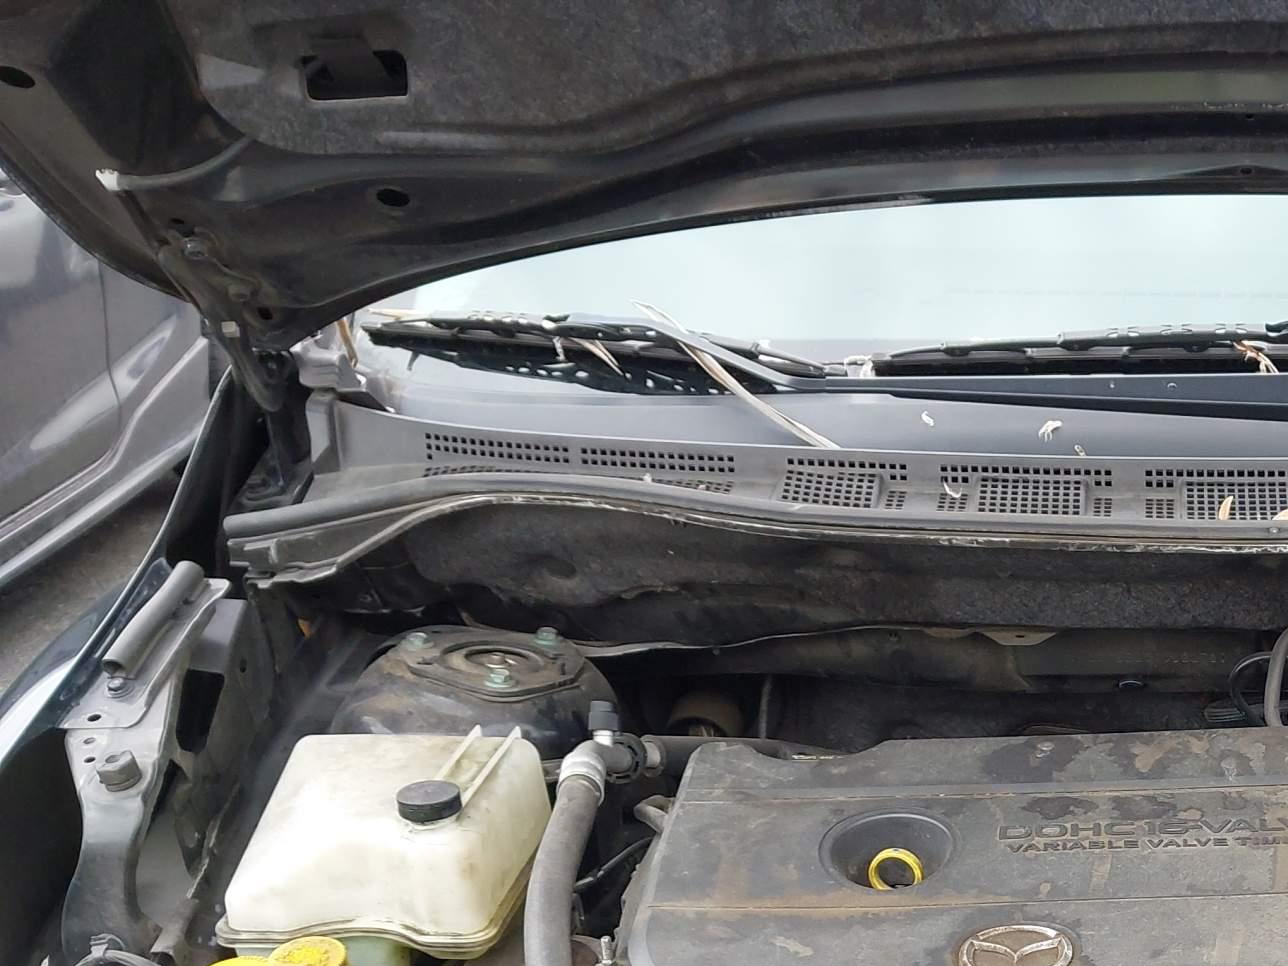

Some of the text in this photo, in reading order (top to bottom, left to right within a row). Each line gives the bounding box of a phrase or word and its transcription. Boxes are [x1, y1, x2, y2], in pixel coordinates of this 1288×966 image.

[999, 821, 1137, 840] DOHC
[1008, 840, 1139, 853] VARIABLE
[1147, 837, 1229, 849] VALVE
